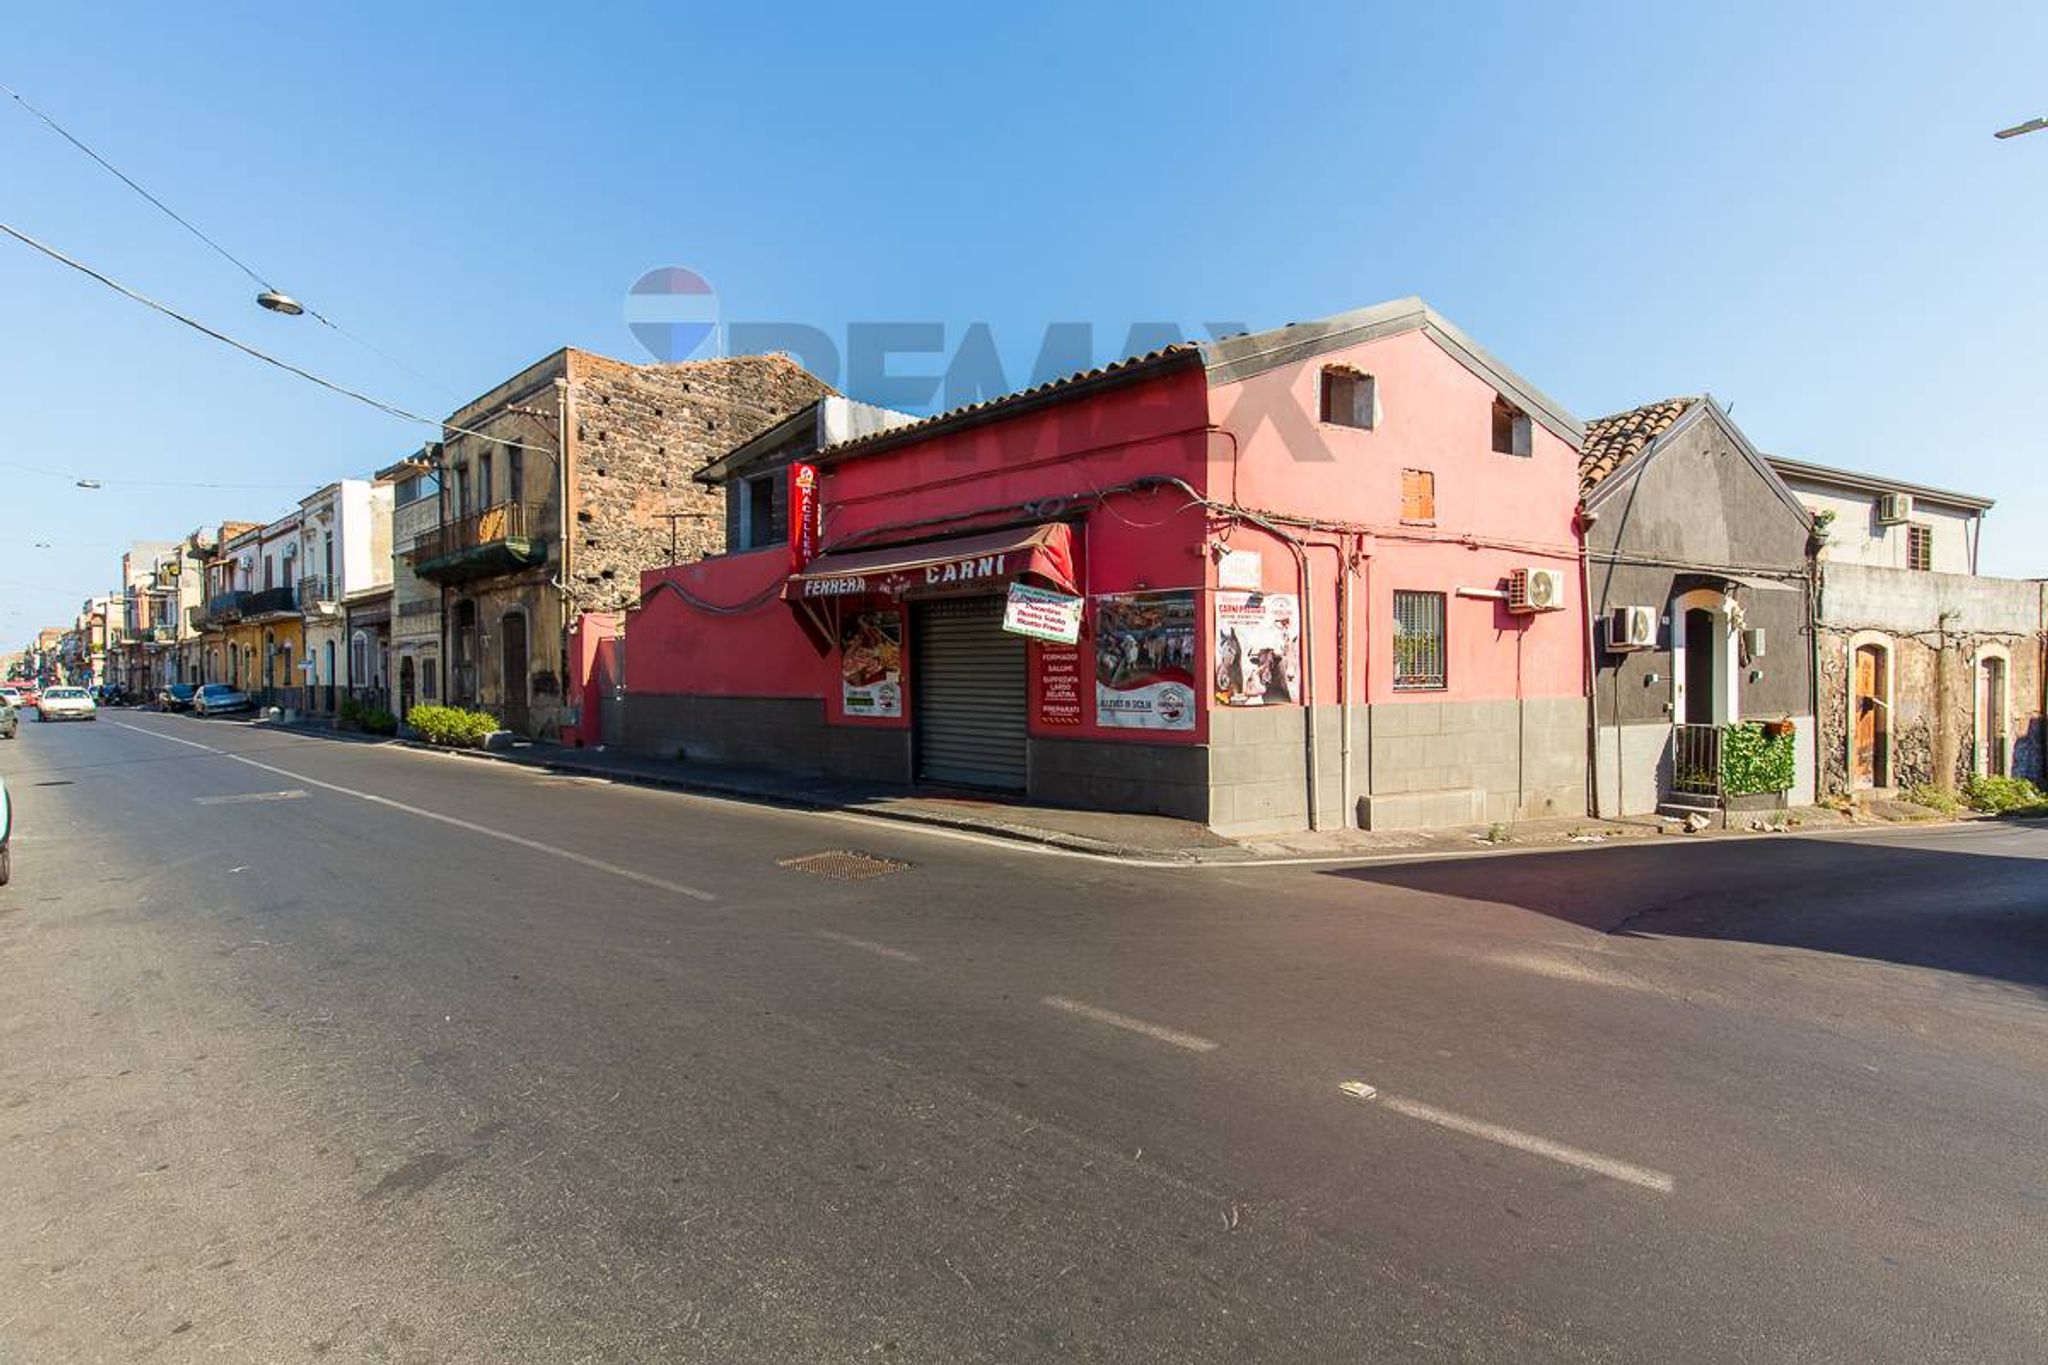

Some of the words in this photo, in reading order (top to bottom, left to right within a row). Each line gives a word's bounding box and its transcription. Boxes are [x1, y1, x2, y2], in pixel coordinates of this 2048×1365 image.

[802, 486, 812, 564] MACELLERI
[805, 576, 866, 596] FERRERA
[926, 554, 1005, 584] CARNI
